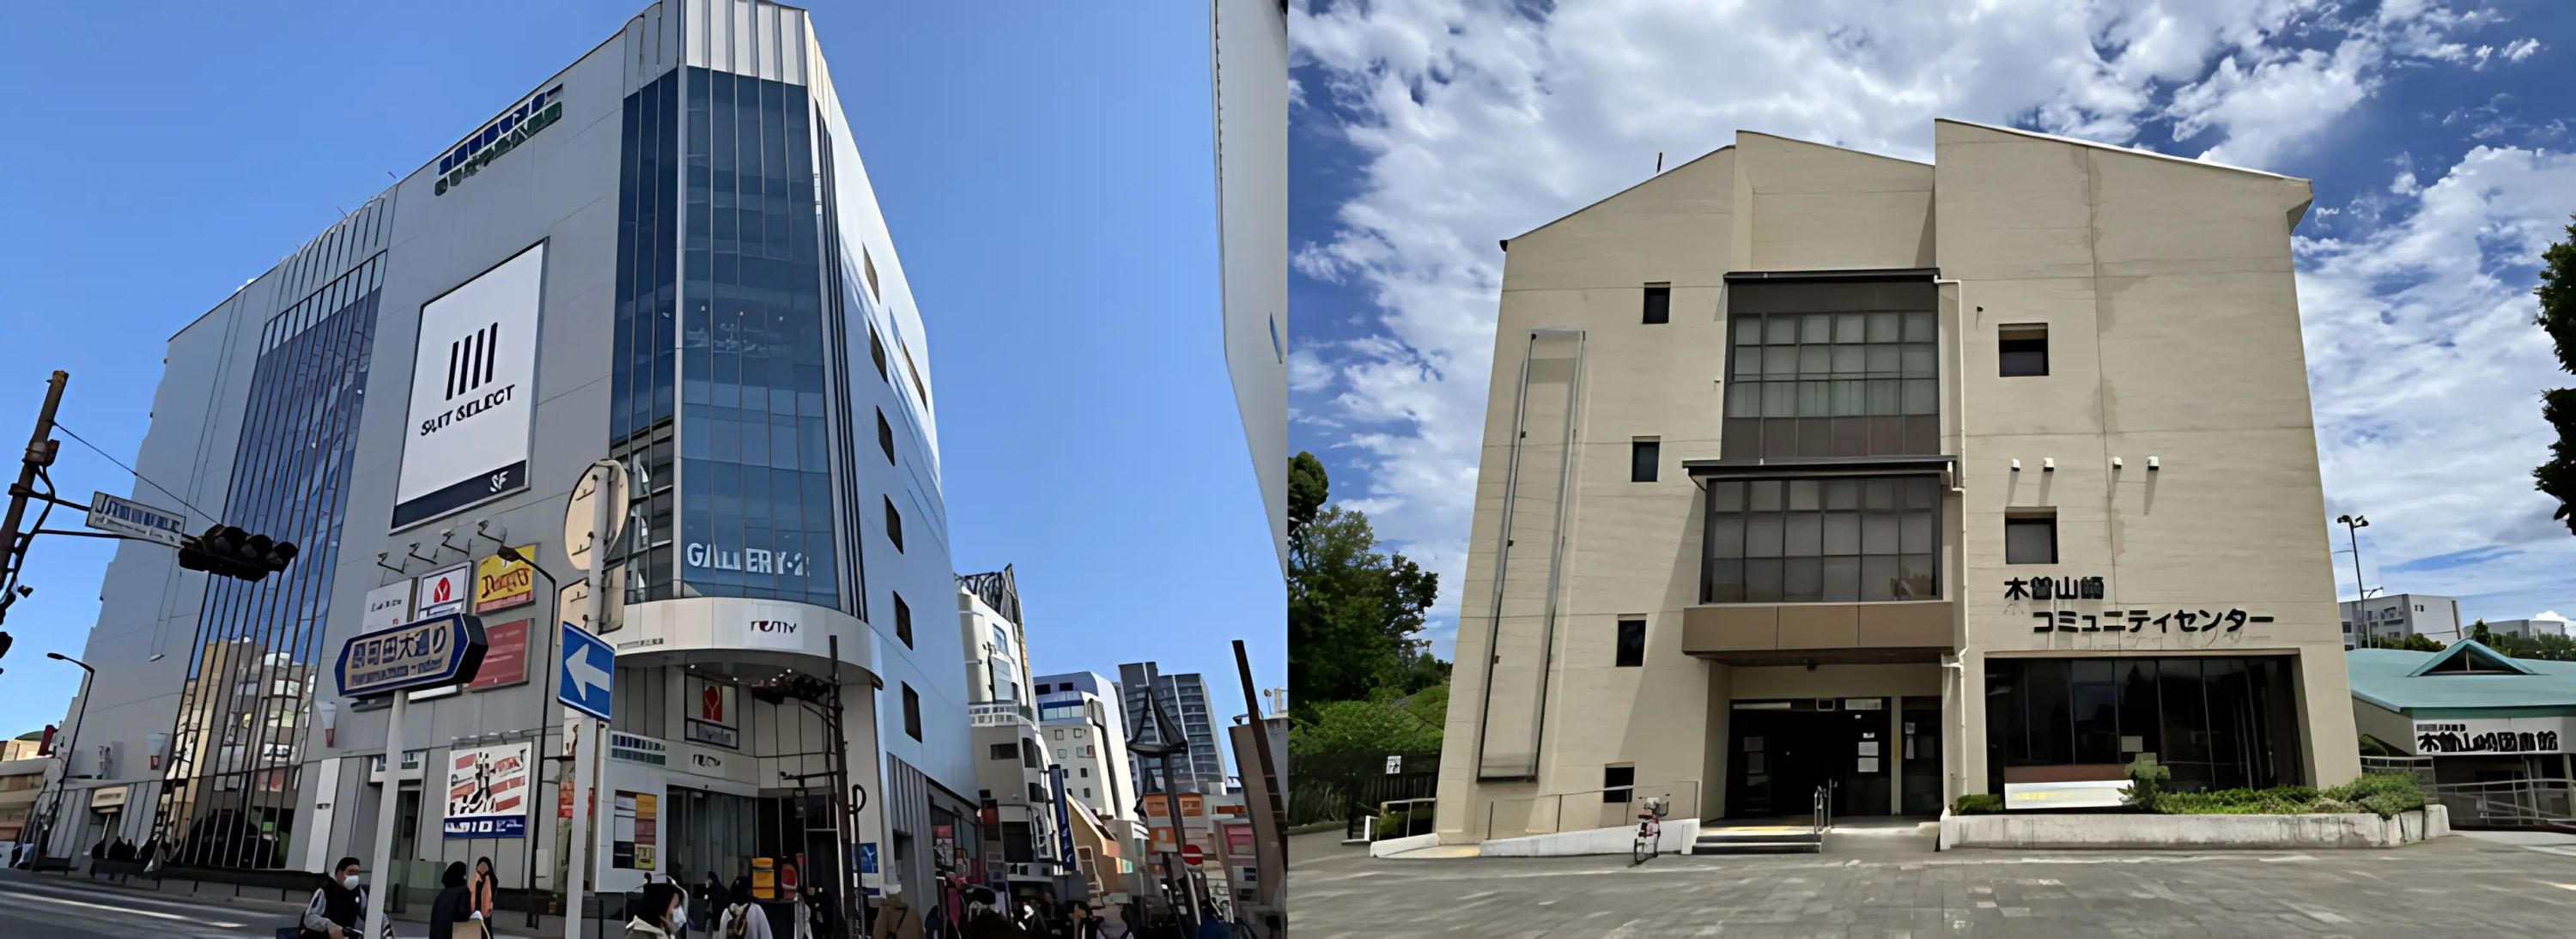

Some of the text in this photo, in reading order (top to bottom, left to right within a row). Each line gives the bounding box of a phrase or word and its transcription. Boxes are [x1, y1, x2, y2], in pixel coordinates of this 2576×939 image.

[455, 384, 515, 421] SELECT
[2032, 609, 2275, 633] コミュニティセンター
